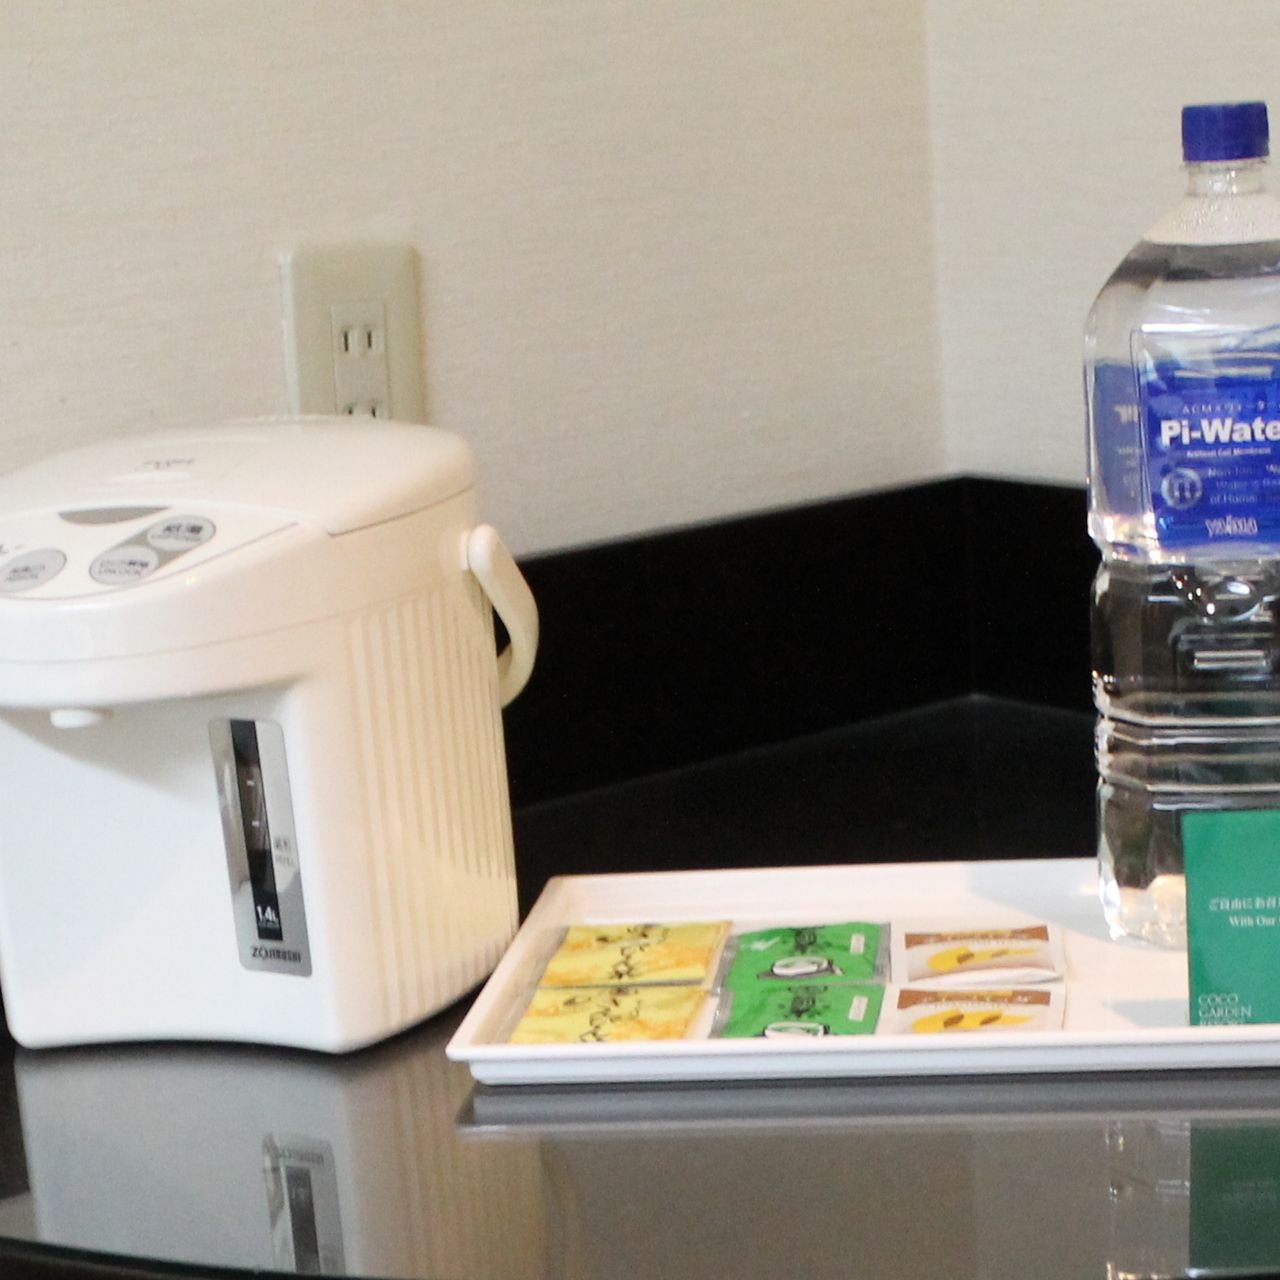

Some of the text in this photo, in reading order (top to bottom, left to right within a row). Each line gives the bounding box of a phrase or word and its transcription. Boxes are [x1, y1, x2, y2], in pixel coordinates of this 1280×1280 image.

[1229, 915, 1254, 927] With
[1256, 915, 1276, 926] Our
[251, 946, 301, 962] ZOJIRUSHI
[1198, 992, 1238, 1005] COCO
[1198, 1005, 1252, 1018] GARDEN
